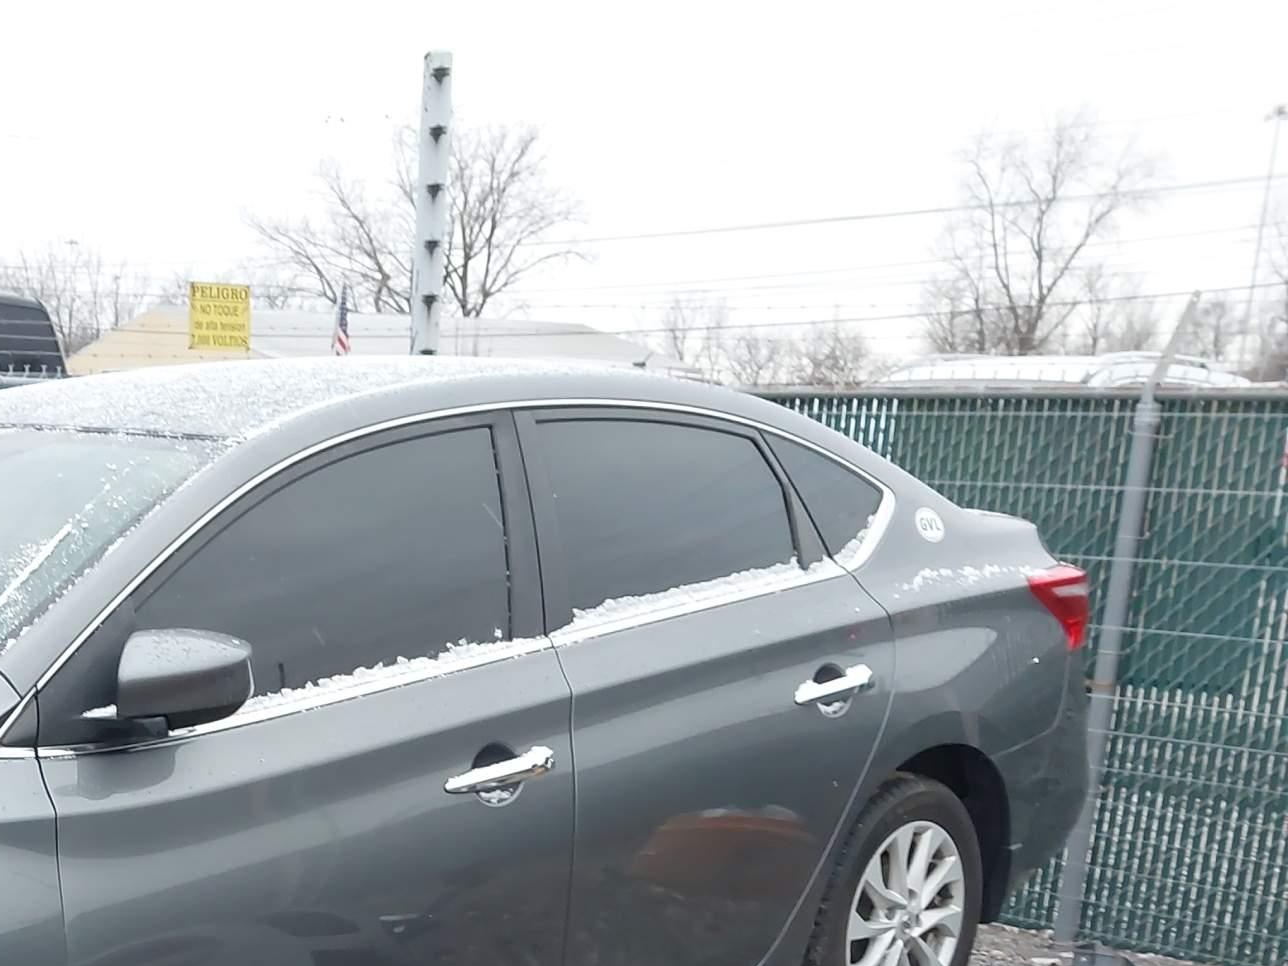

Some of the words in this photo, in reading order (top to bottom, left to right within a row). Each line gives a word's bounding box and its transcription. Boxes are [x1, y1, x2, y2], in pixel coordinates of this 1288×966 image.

[192, 286, 248, 300] PELIGRO
[200, 304, 212, 316] NO
[213, 304, 239, 317] TOQUE
[919, 517, 942, 531] GVL
